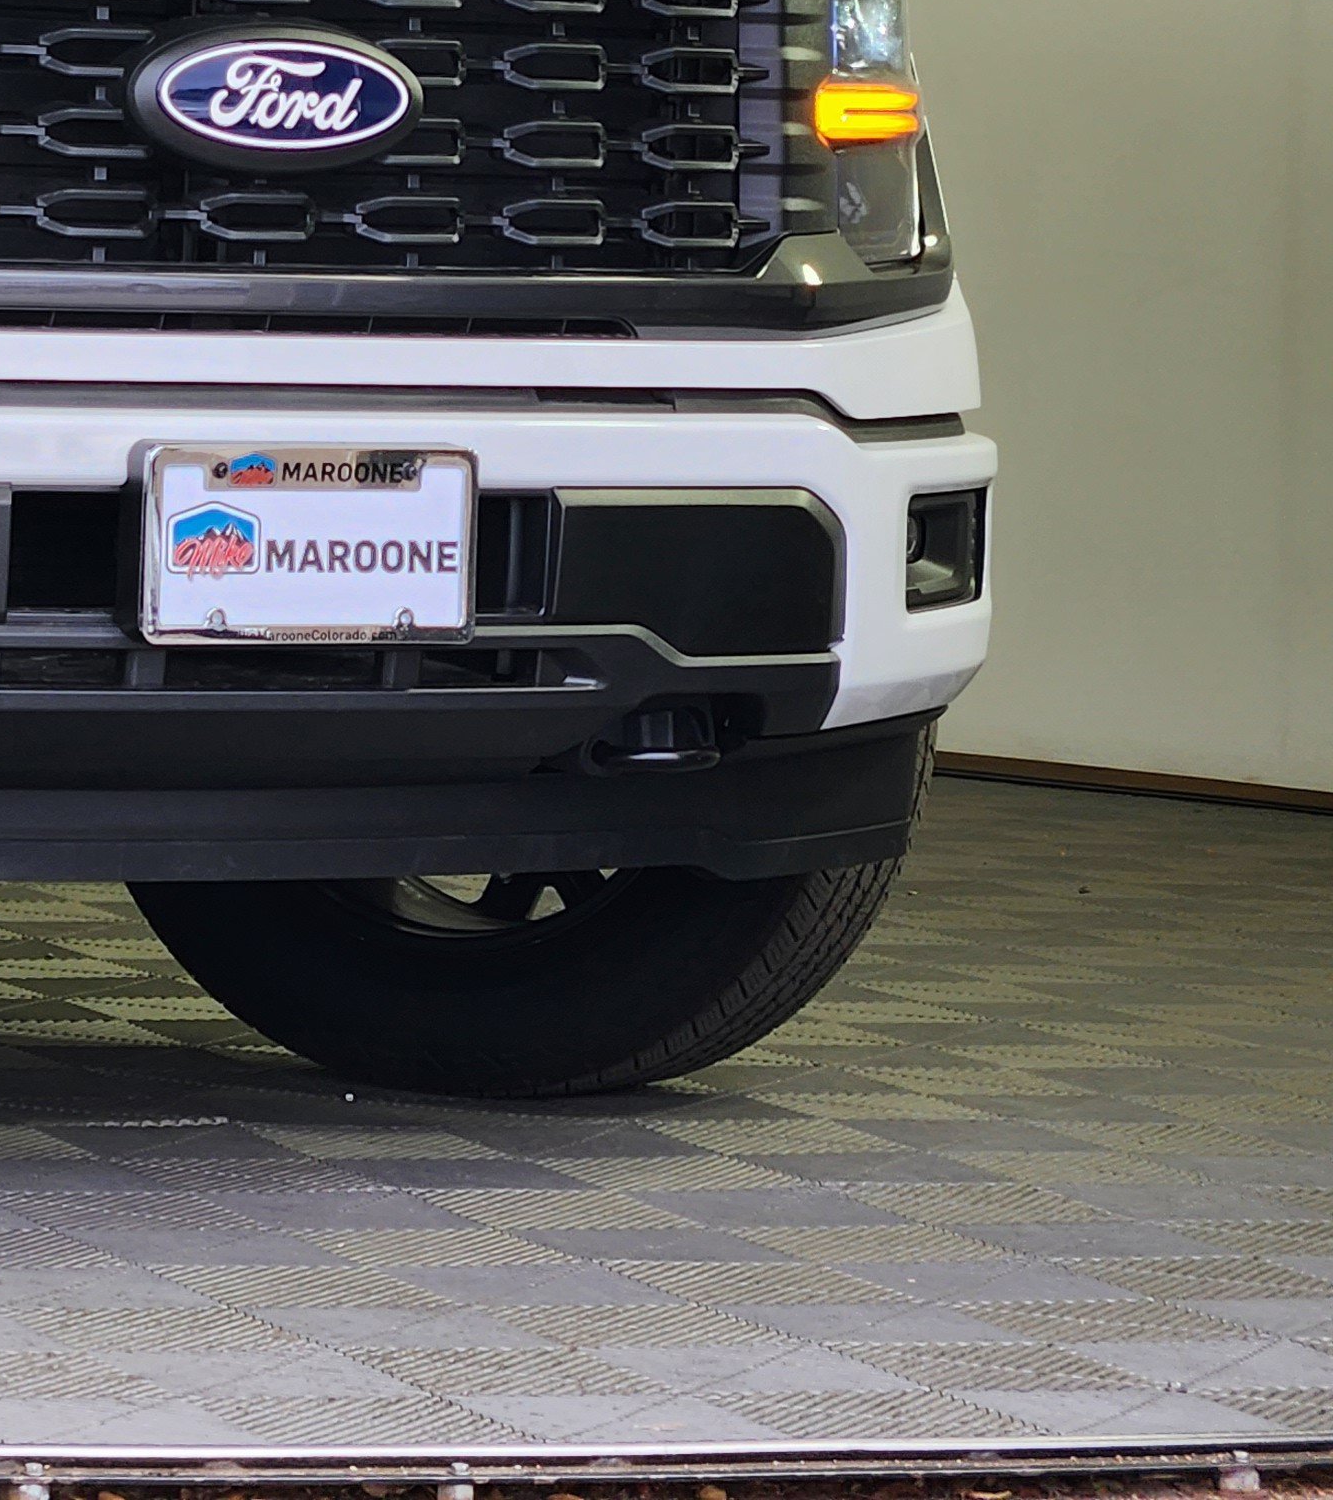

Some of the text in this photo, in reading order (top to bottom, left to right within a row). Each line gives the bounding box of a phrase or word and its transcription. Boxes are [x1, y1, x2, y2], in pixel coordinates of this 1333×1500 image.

[209, 55, 364, 132] Ford
[282, 461, 405, 485] MAROONE
[174, 535, 255, 579] Mike
[264, 539, 459, 574] MAROONE
